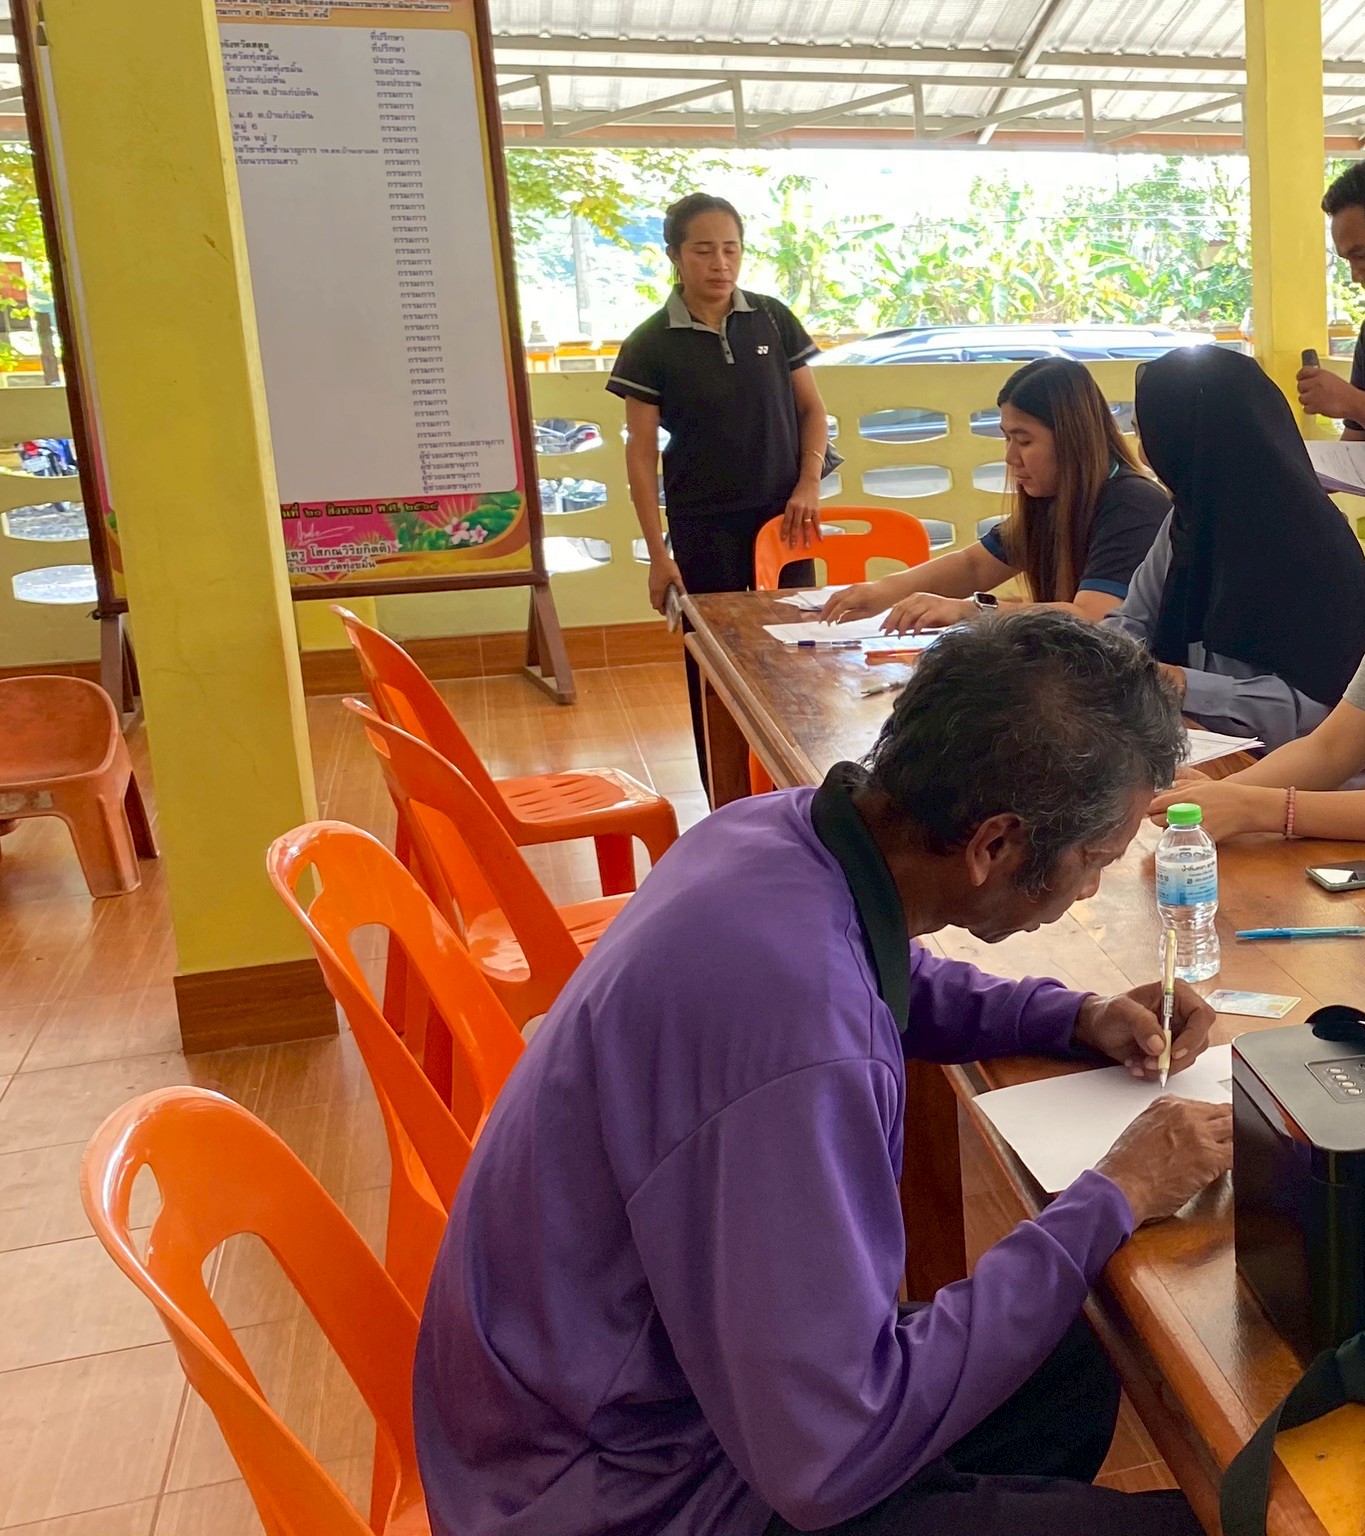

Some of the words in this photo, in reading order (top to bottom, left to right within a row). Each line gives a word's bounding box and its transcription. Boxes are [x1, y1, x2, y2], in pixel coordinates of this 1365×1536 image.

[370, 30, 404, 42] ที่ปรึกษา
[371, 42, 406, 53] ที่ปรึกษา
[372, 56, 405, 64] ประธาน
[374, 67, 421, 76] รองประธาน
[375, 78, 422, 87] รองประธาน
[414, 409, 449, 417] กรรมการ
[416, 420, 450, 428] กรรมการ
[416, 430, 452, 439] กรรมการ
[326, 502, 372, 517] สิงหาคม
